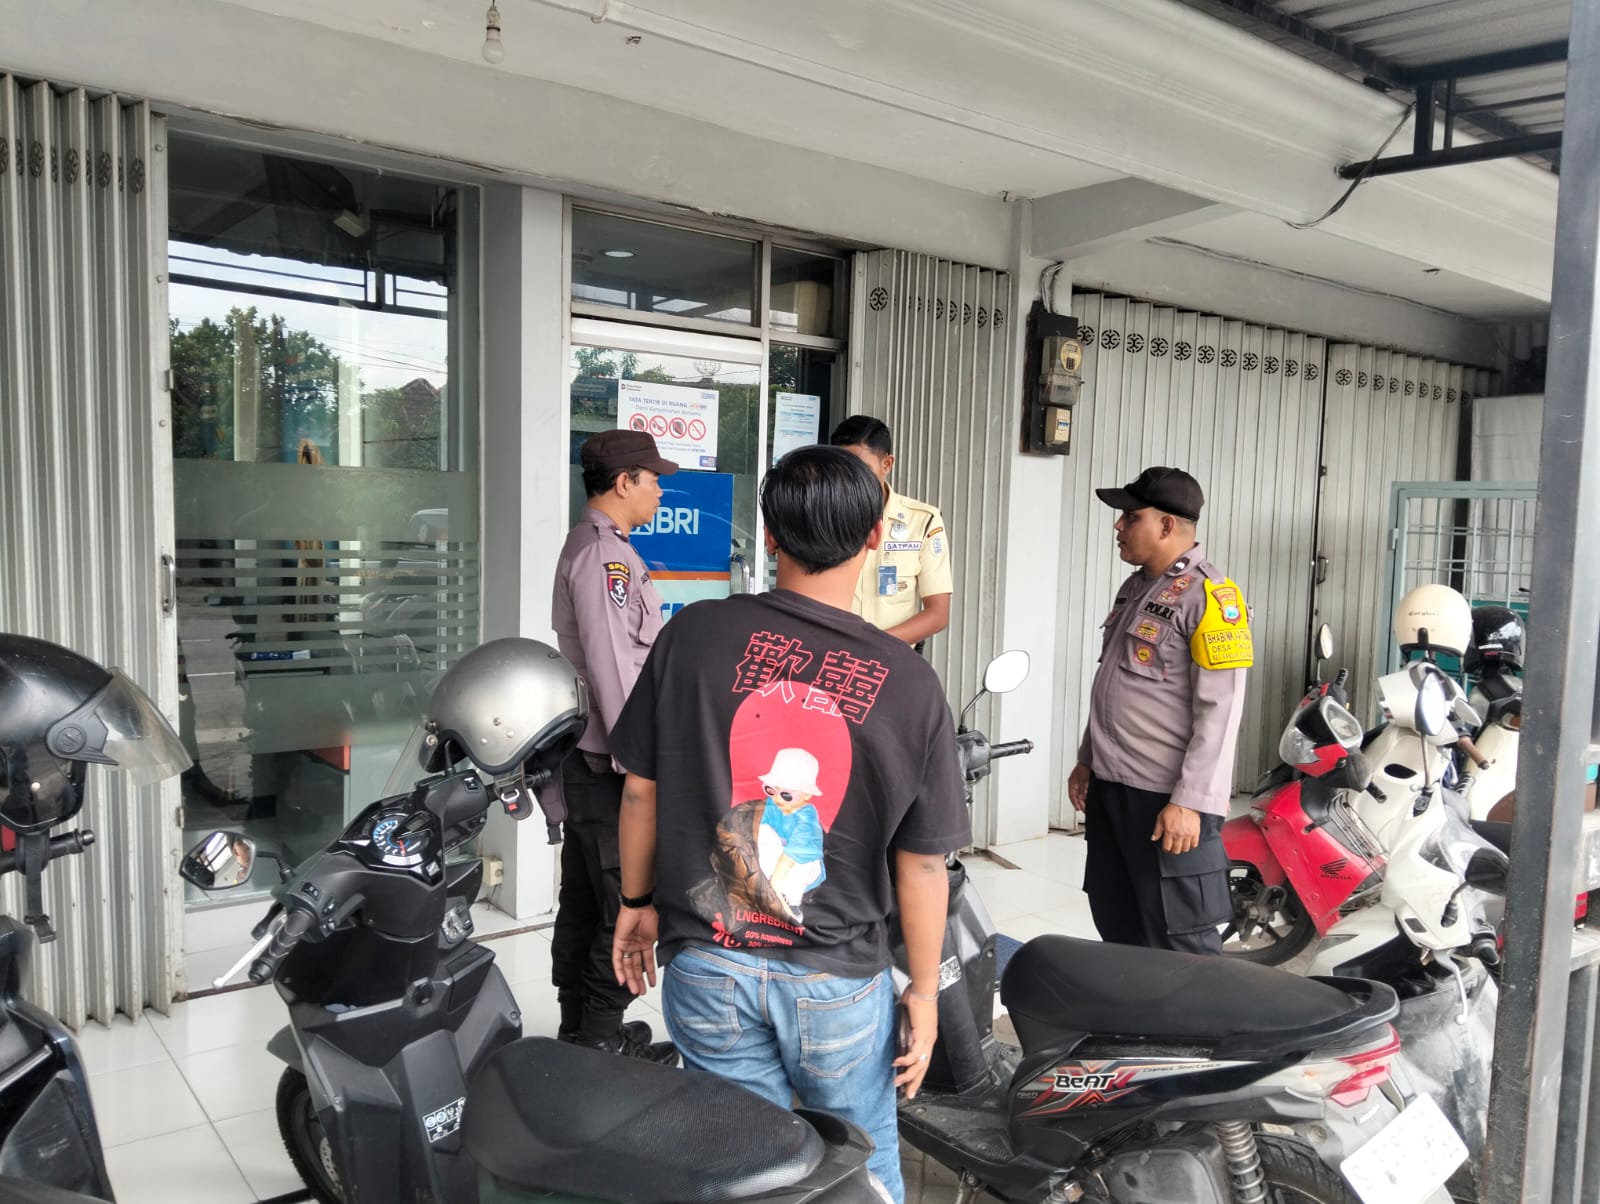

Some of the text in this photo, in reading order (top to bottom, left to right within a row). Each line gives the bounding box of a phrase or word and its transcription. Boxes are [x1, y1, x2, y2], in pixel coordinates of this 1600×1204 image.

[656, 507, 699, 535] BRI
[887, 543, 919, 551] SATPAM
[1144, 602, 1175, 620] POLRI
